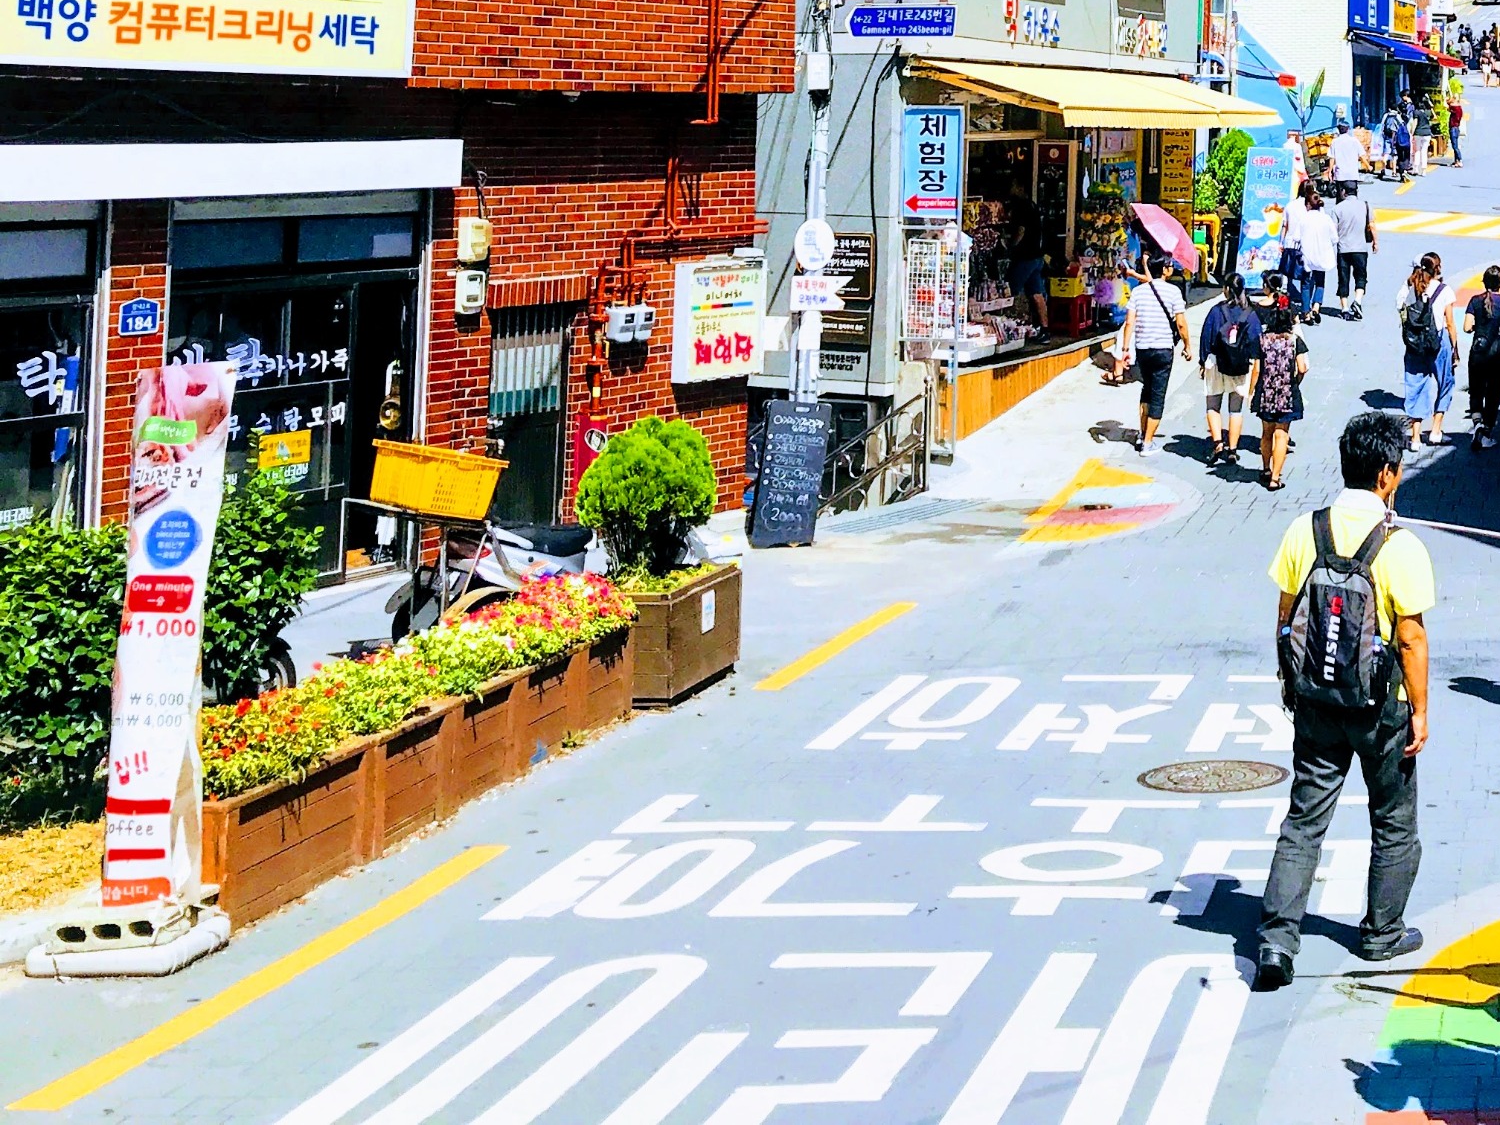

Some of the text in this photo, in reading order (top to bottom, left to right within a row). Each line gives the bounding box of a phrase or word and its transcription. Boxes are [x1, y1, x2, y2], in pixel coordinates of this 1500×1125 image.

[107, 0, 314, 53] 컴퓨터크리닝
[318, 13, 380, 55] 세탁
[853, 8, 954, 25] 14-22 감내1로243번길
[1023, 5, 1061, 43] 하우스
[861, 25, 952, 37] Gamnae 1-ro 243beon-gil
[918, 113, 948, 193] 체험장
[917, 199, 956, 209] experience
[126, 315, 153, 331] 184
[309, 347, 349, 374] 가죽
[131, 581, 194, 593] One minute
[480, 792, 1370, 923] 보호구역
